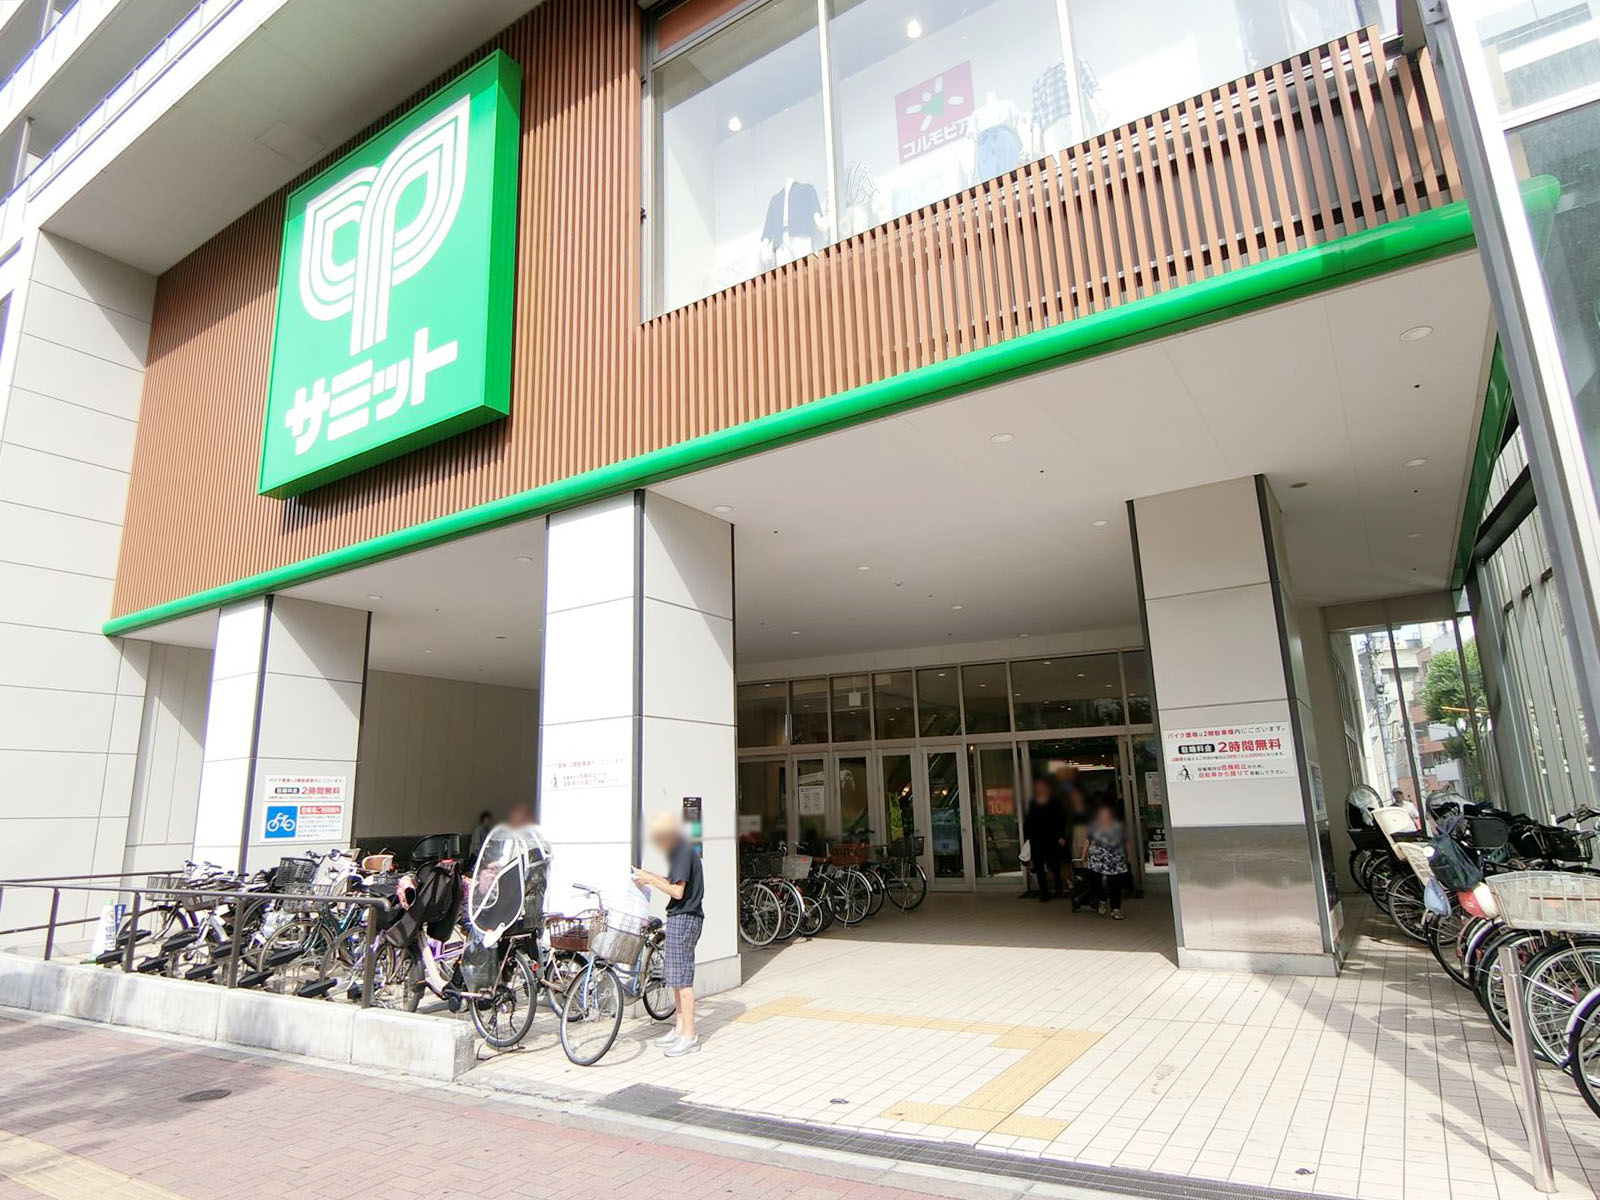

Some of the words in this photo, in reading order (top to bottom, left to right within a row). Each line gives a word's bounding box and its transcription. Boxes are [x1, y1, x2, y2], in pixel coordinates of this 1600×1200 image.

[285, 326, 458, 456] サミット
[1218, 738, 1281, 752] 2時間無料
[301, 786, 340, 795] 2時間無料
